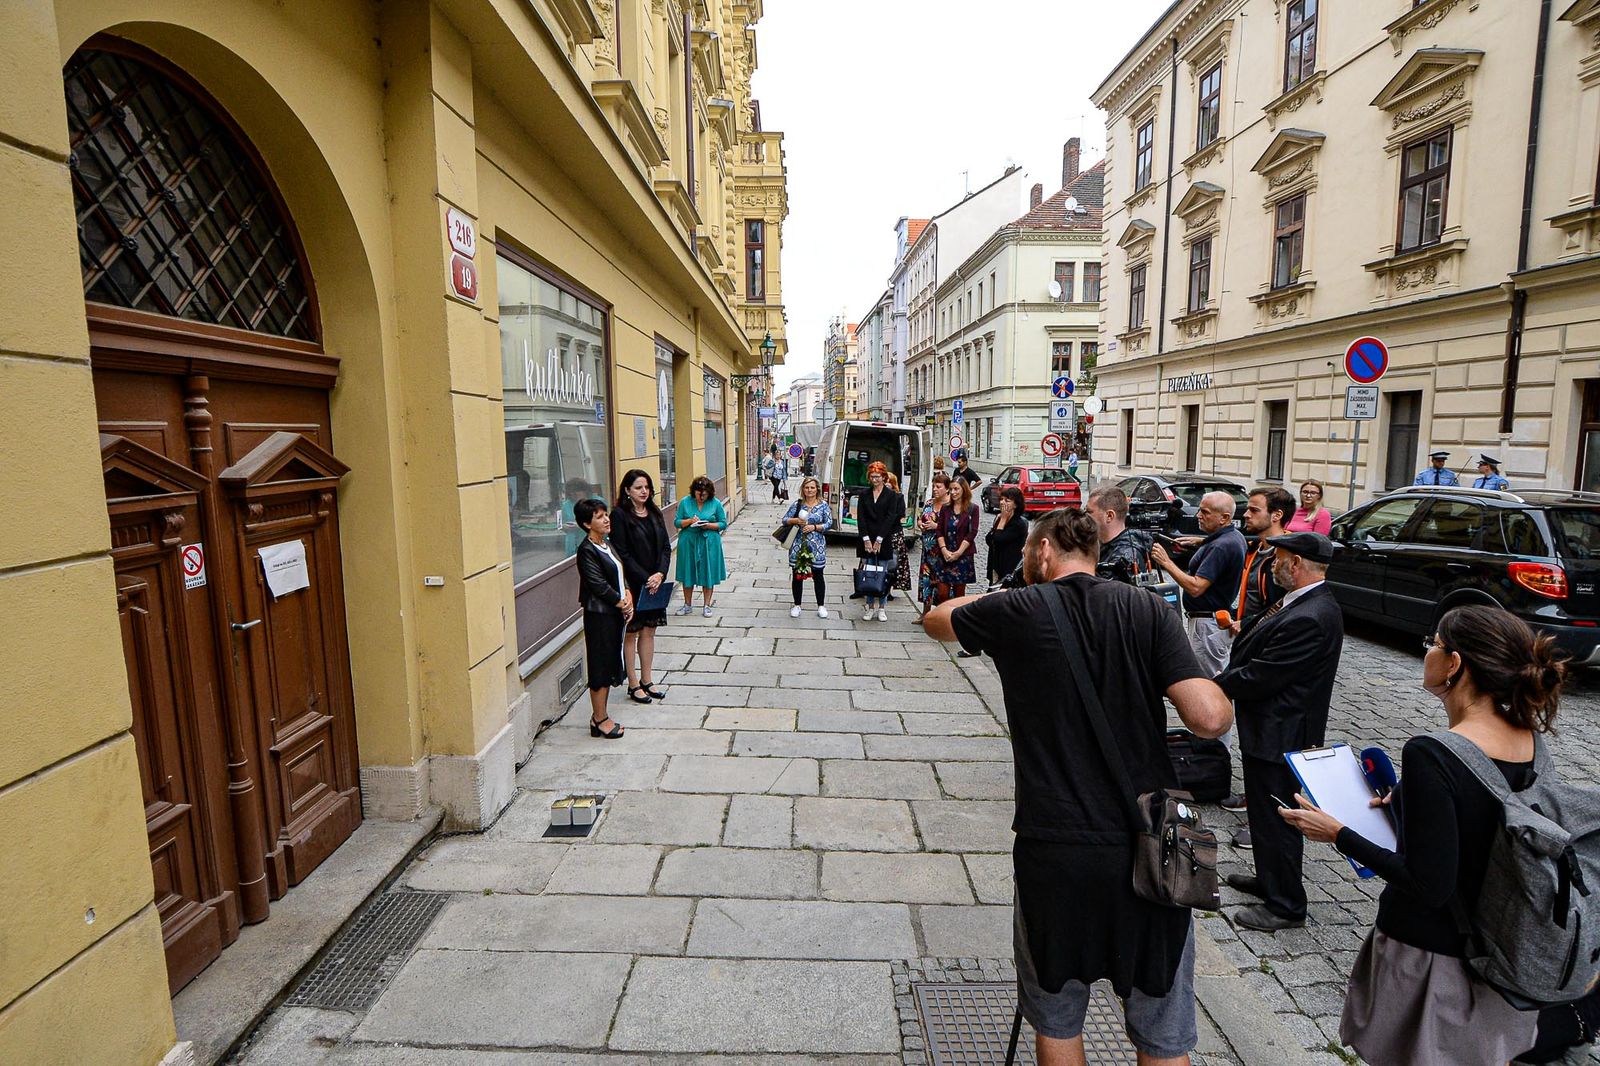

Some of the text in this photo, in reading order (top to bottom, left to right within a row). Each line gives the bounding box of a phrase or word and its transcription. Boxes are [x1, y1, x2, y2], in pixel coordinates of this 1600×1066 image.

[456, 219, 472, 248] 216
[462, 266, 472, 290] 19
[523, 338, 595, 407] kulturka
